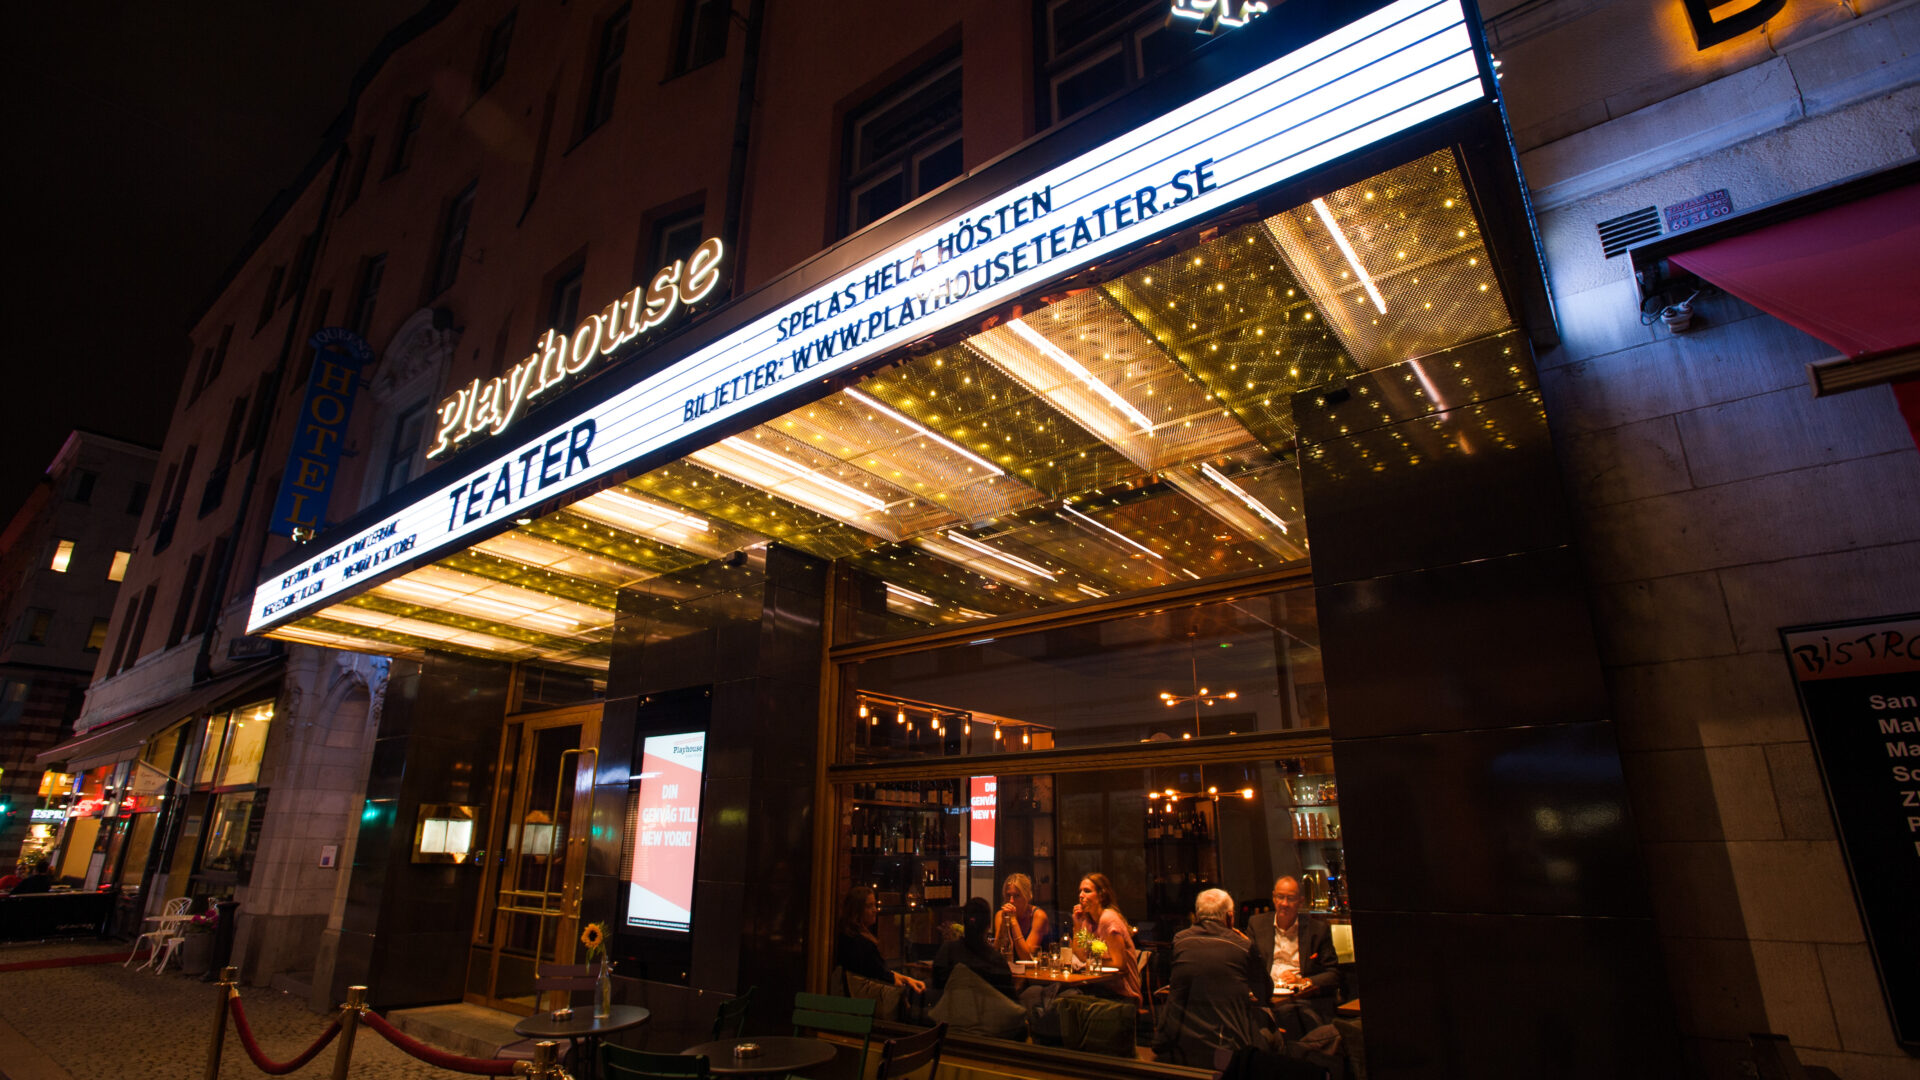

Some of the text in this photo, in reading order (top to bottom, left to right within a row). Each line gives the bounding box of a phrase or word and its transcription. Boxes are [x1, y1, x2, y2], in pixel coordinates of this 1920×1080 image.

[1712, 206, 1730, 217] 00
[776, 185, 1051, 343] SPELAS HELA HÖSTEN
[683, 158, 1218, 422] BILJETTER: WWW.PLAYHOUSETEATER.SE
[427, 237, 723, 459] Playhouse
[285, 360, 357, 527] HOTEL
[448, 418, 596, 532] TEATER
[1869, 694, 1918, 710] San
[673, 745, 703, 755] Playhouse
[661, 784, 679, 800] DIN
[642, 804, 697, 823] GENVÄG TILL
[641, 830, 692, 847] NEW YORK!
